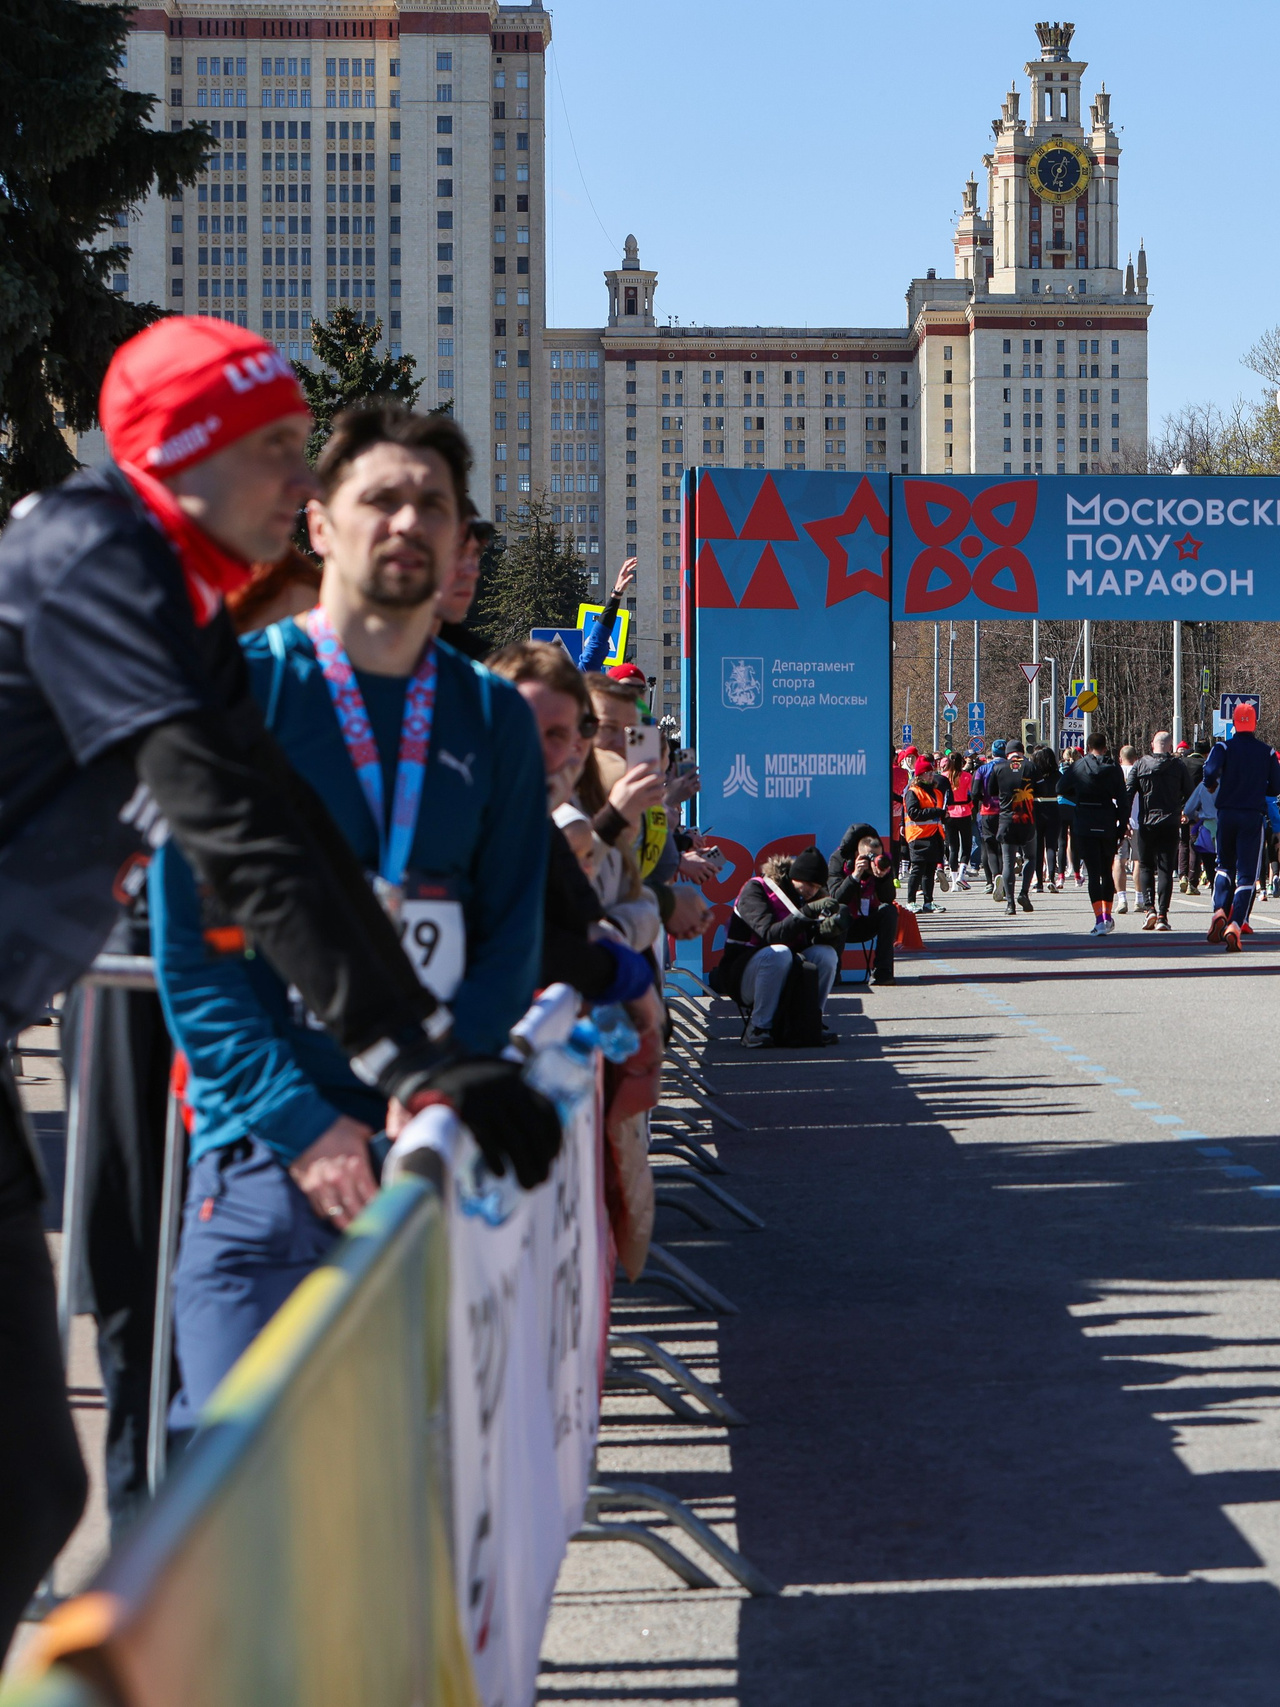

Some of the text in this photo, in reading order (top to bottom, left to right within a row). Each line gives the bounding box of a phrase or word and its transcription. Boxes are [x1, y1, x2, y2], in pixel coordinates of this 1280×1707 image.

[1066, 533, 1171, 561] ПОЛУ
[1066, 568, 1254, 596] МАРАФОН
[771, 659, 856, 674] Департамент
[772, 678, 815, 691] спорта
[772, 693, 868, 708] города Москвы
[764, 749, 867, 776] МОСКОВСКИЙ
[764, 777, 813, 798] СПОРТ
